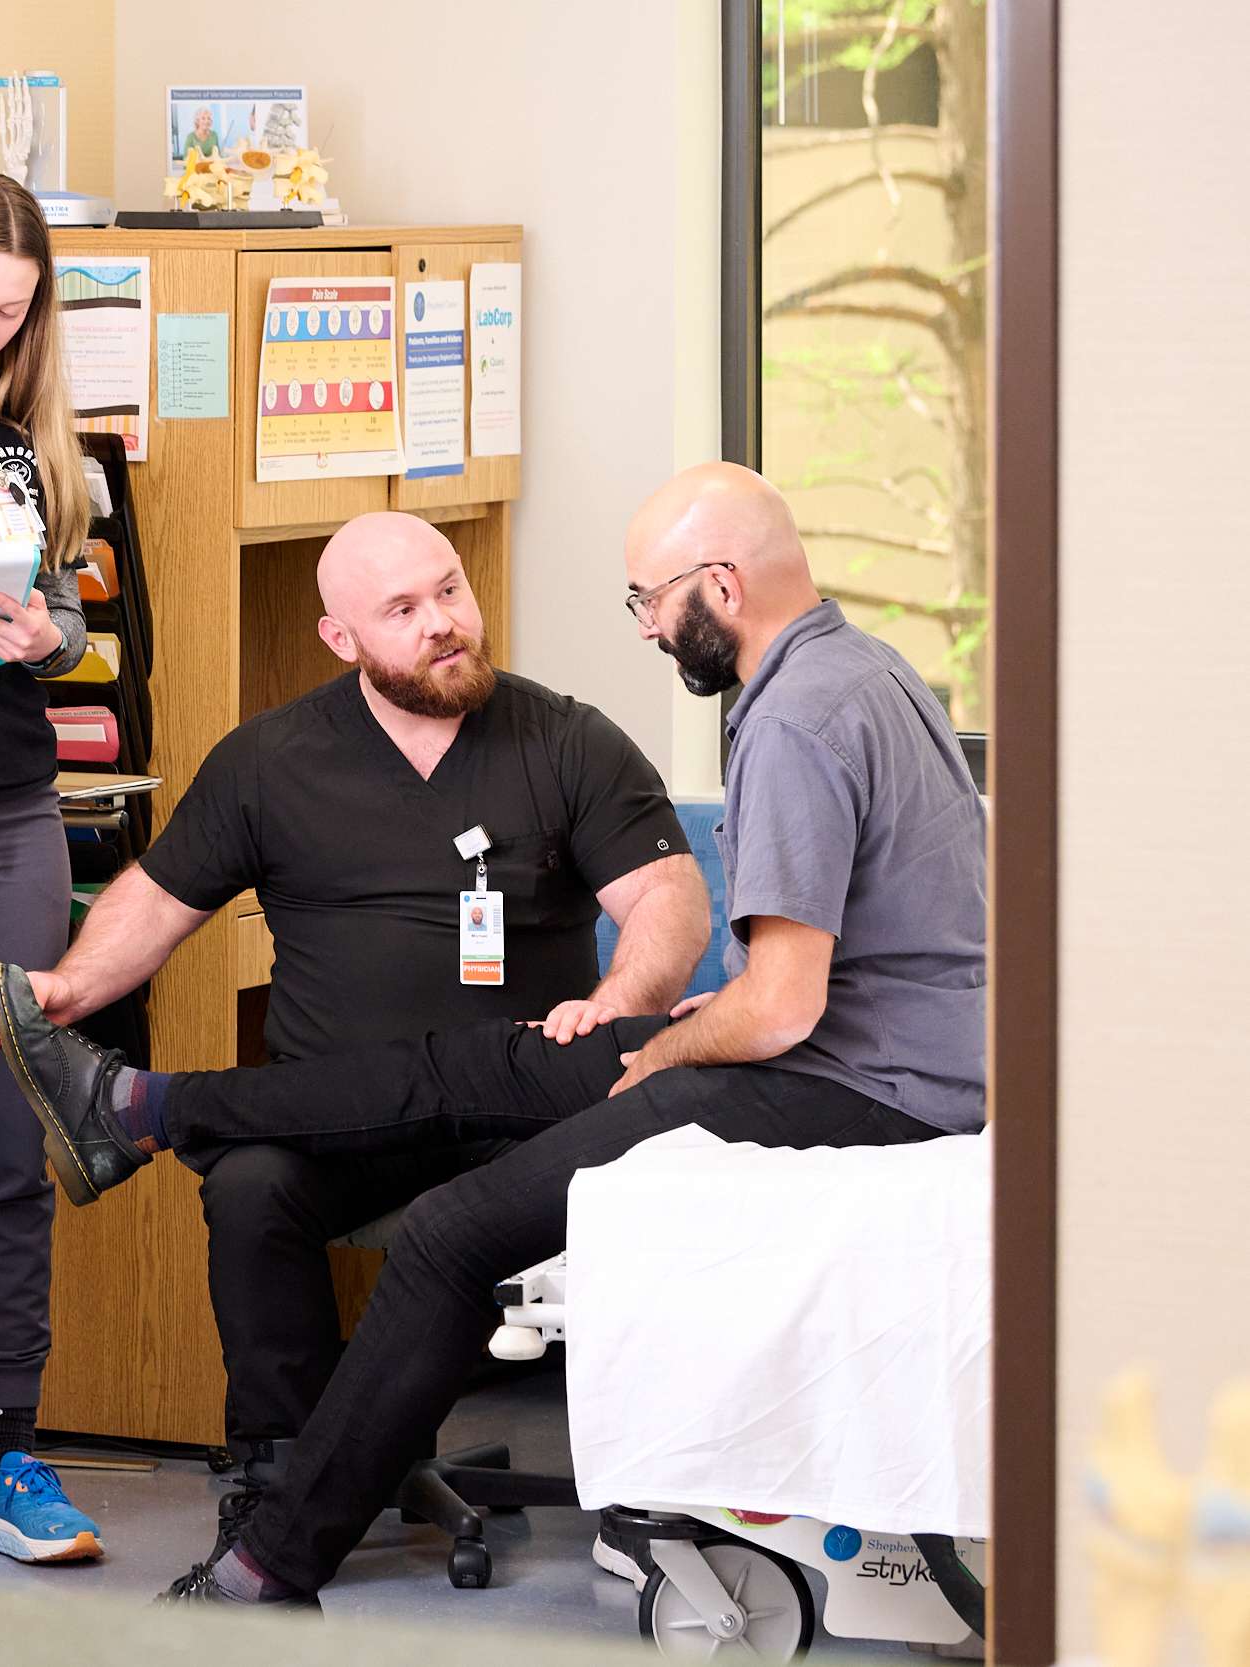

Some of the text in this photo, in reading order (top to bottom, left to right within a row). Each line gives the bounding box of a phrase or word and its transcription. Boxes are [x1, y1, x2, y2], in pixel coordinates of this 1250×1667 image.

[312, 289, 338, 300] Pain Scale
[478, 307, 512, 328] LabCorp
[462, 966, 501, 974] PHYSICIAN
[856, 1556, 938, 1586] stryk
